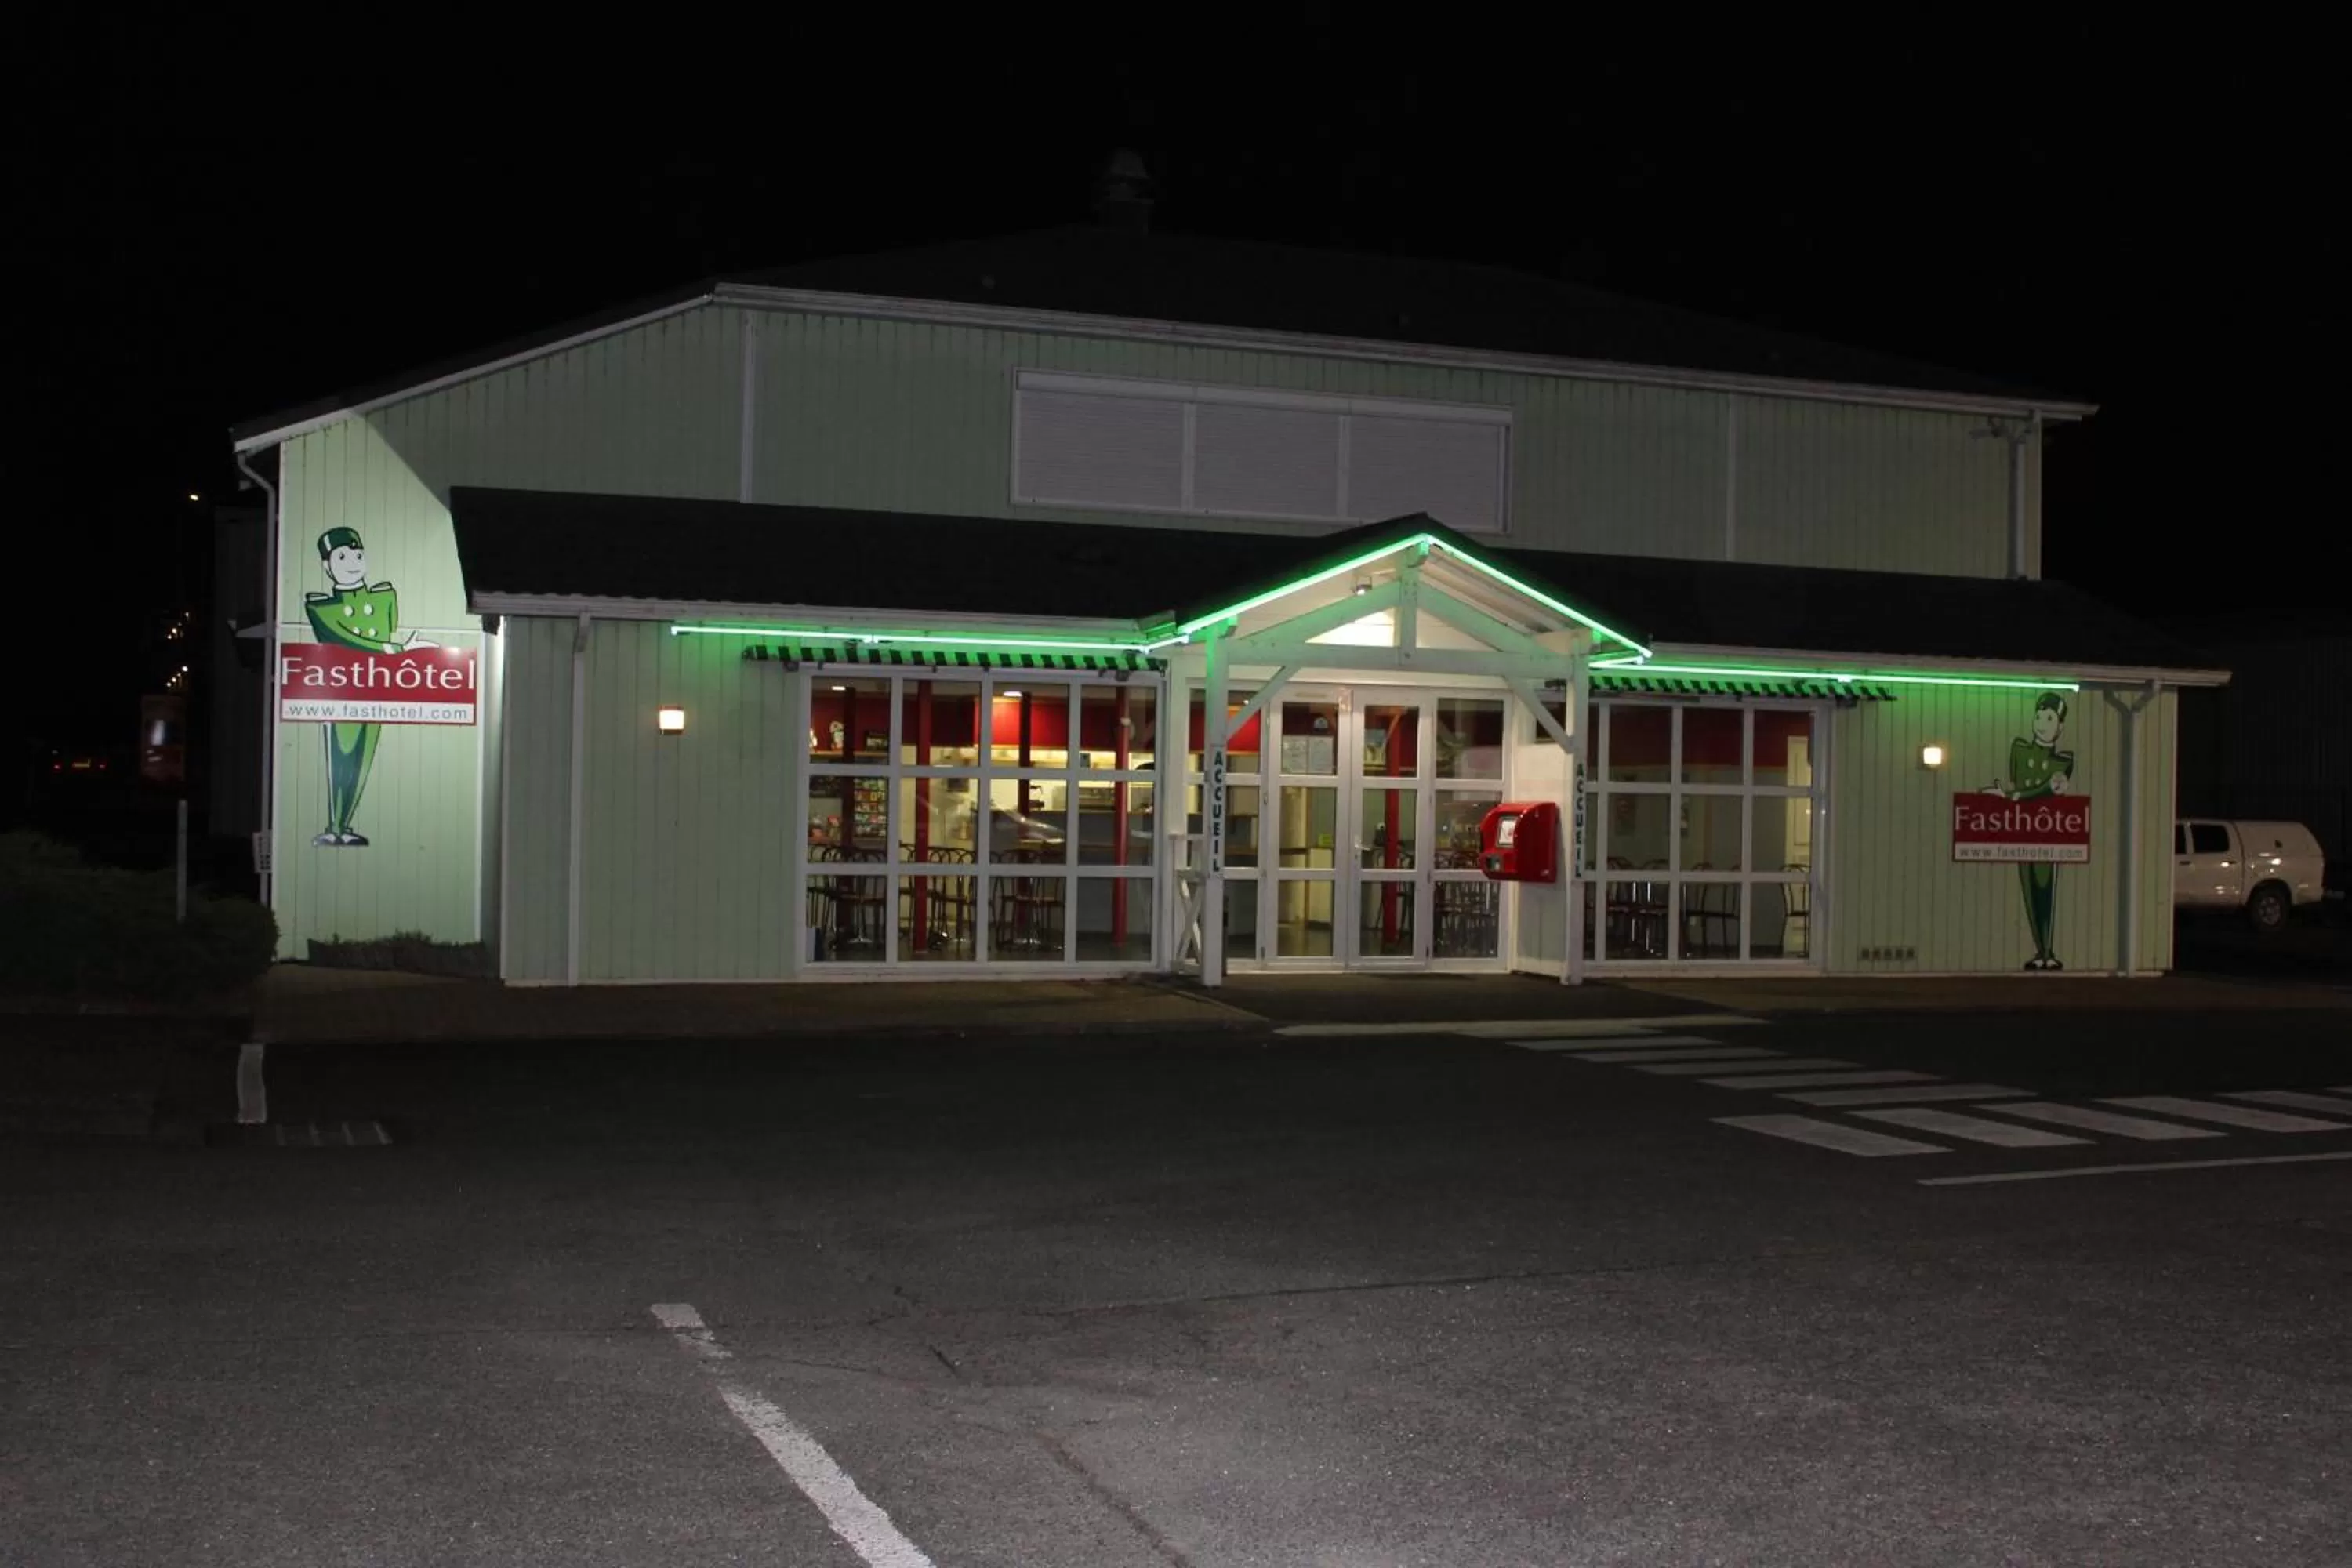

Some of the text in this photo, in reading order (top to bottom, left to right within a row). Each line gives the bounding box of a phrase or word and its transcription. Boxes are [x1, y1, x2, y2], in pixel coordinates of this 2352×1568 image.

[281, 656, 475, 689] Fasthôtel
[289, 704, 468, 720] www.fasthotel.com
[1212, 750, 1224, 872] ACCUEIL
[1575, 763, 1584, 877] ACCUEIL
[1955, 804, 2089, 833] Fasthôtel
[1960, 846, 2083, 858] www.fasthotel.com
